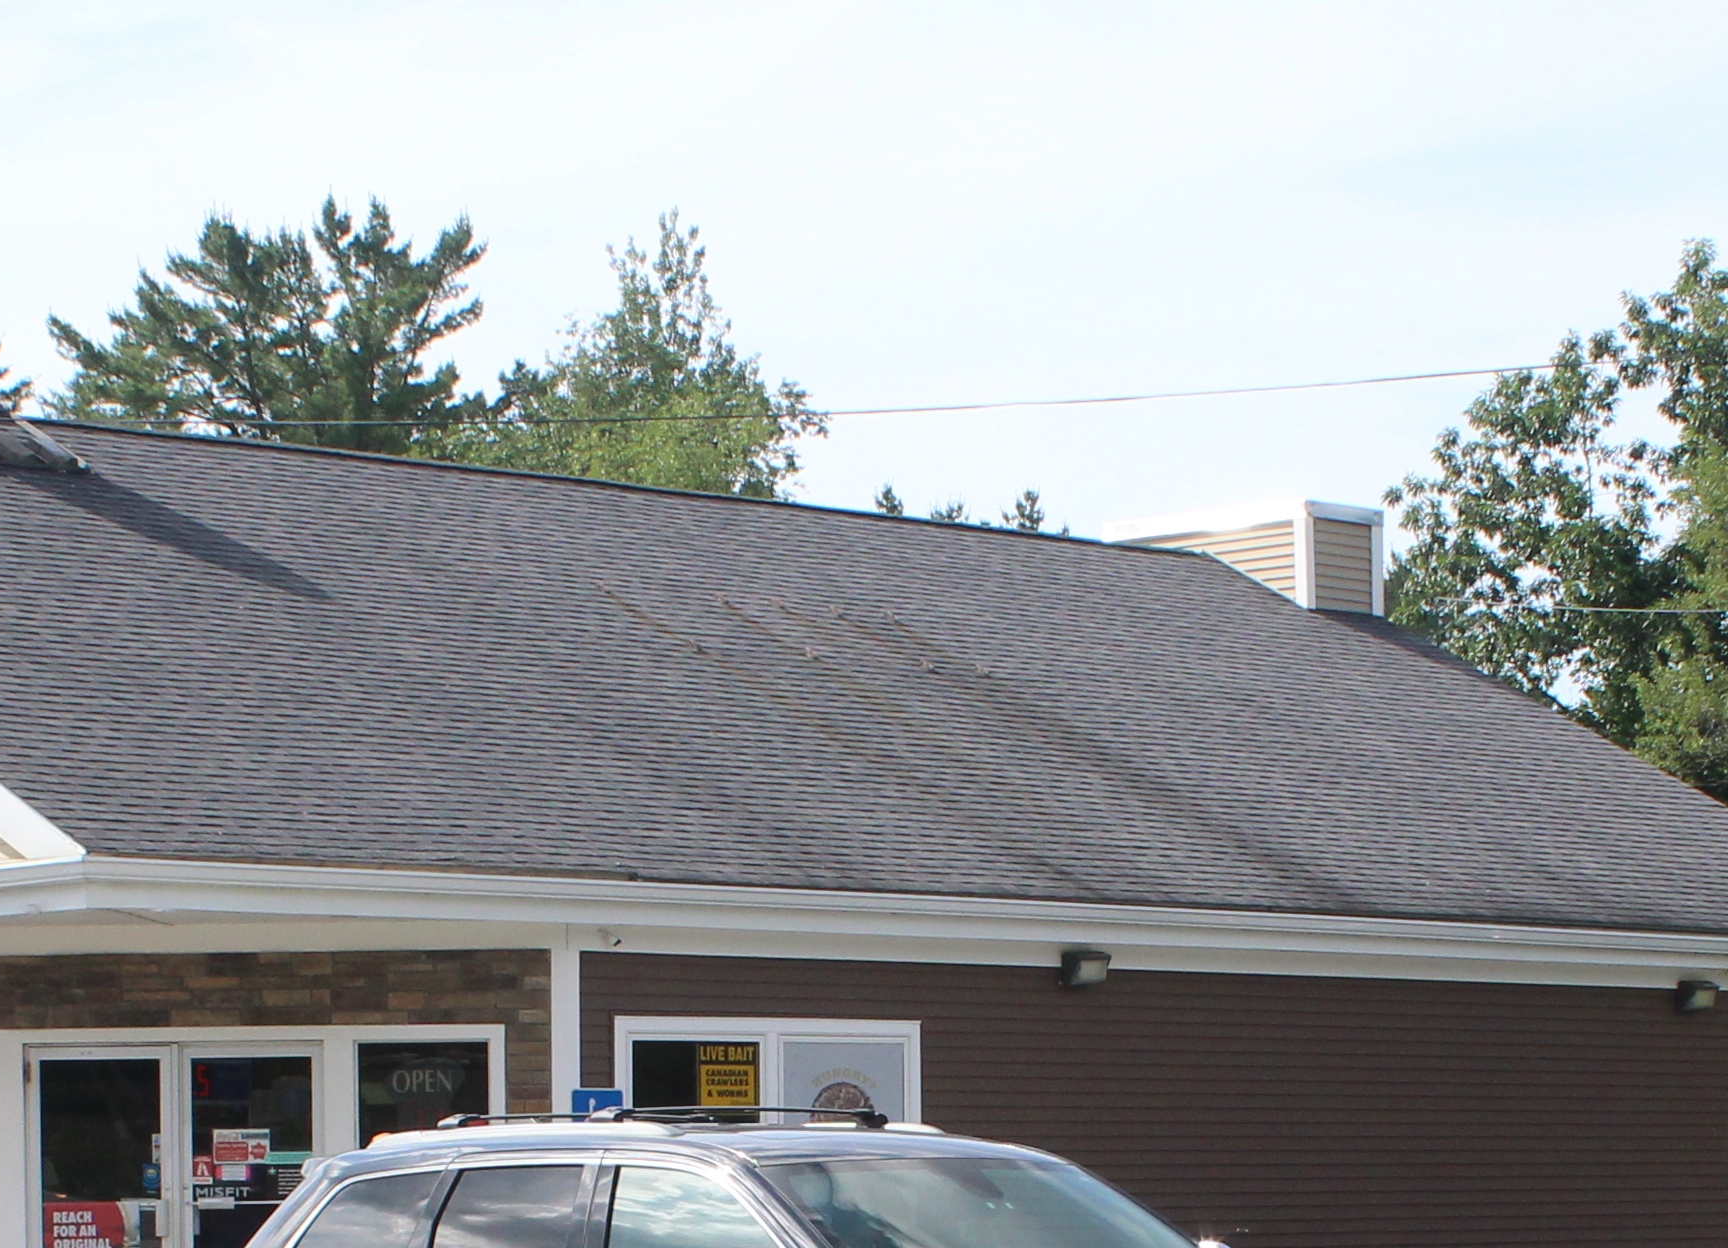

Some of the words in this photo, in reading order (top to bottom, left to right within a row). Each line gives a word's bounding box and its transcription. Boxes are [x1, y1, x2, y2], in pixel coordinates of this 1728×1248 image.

[700, 1046, 726, 1061] LIVE
[728, 1046, 755, 1061] BAIT
[392, 1069, 452, 1093] OPEN
[705, 1078, 749, 1086] CRAWLERS
[706, 1089, 713, 1097] &
[716, 1089, 749, 1098] WORMS
[195, 1186, 249, 1198] MISFIT
[53, 1211, 92, 1223] REACH
[53, 1225, 76, 1237] FOR
[78, 1225, 96, 1237] AN
